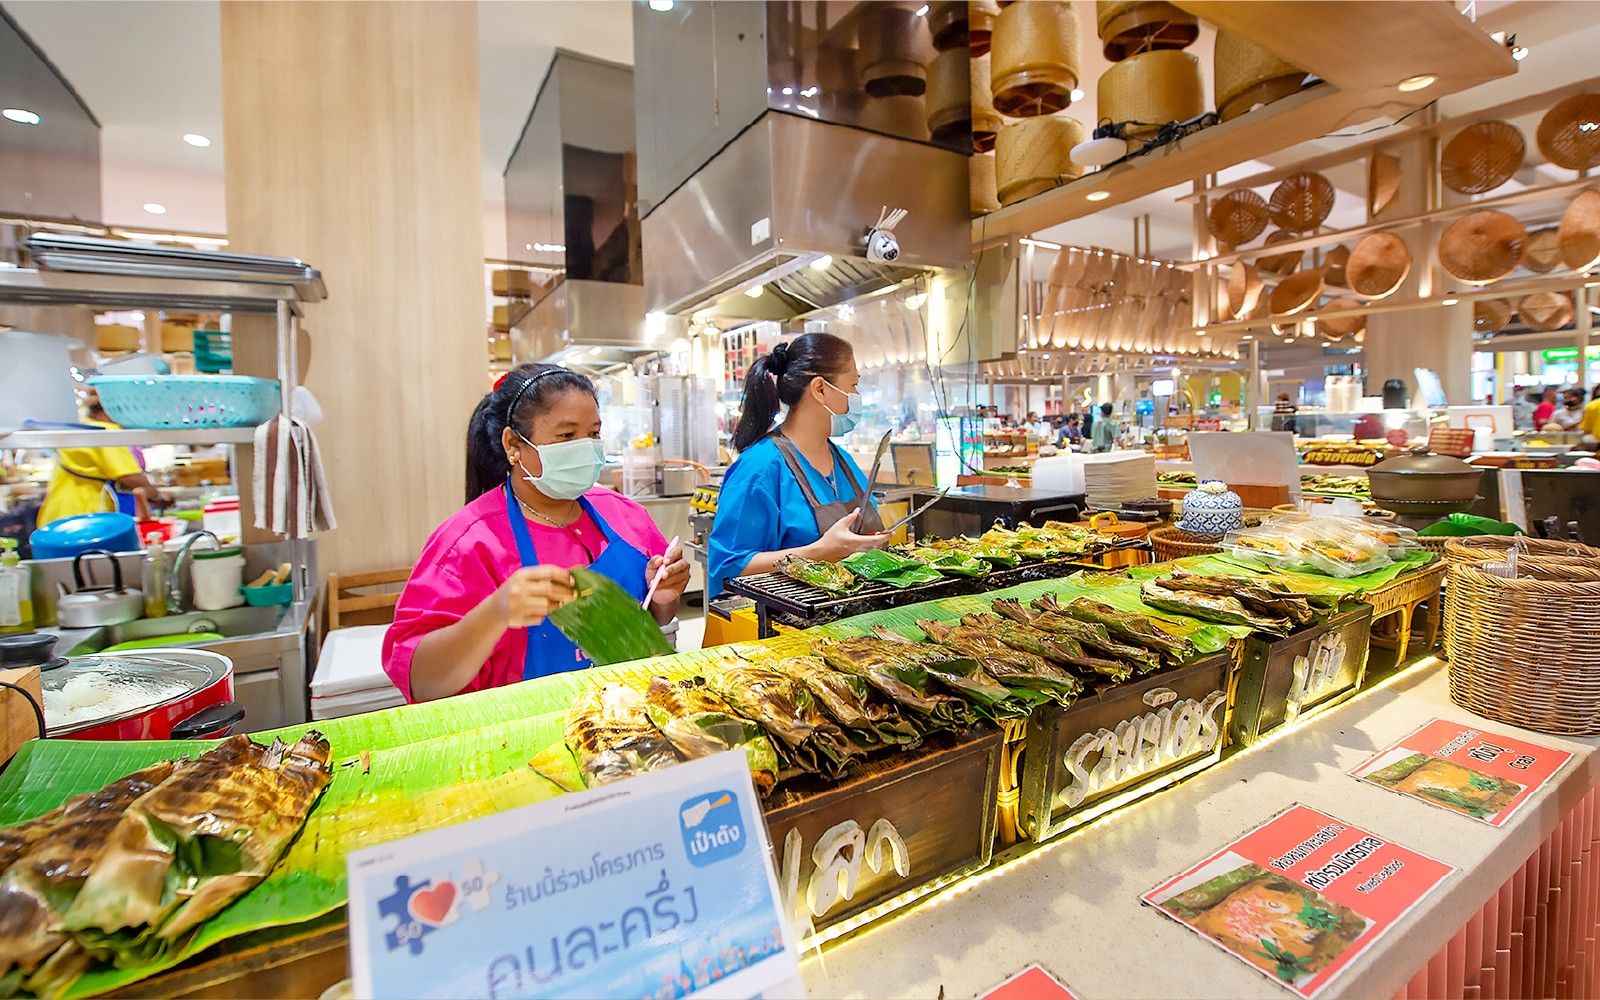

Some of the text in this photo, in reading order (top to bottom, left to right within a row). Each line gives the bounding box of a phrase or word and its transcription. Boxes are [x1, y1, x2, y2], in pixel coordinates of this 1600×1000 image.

[1059, 687, 1229, 808] รวมมิตร
[1507, 754, 1537, 771] Crab
[462, 876, 484, 897] 50
[504, 842, 665, 910] ร้านนี้ร่วมโครงการ
[1355, 875, 1382, 895] Mixed
[395, 920, 423, 944] 50
[487, 868, 699, 1000] คนละครึ่ง
